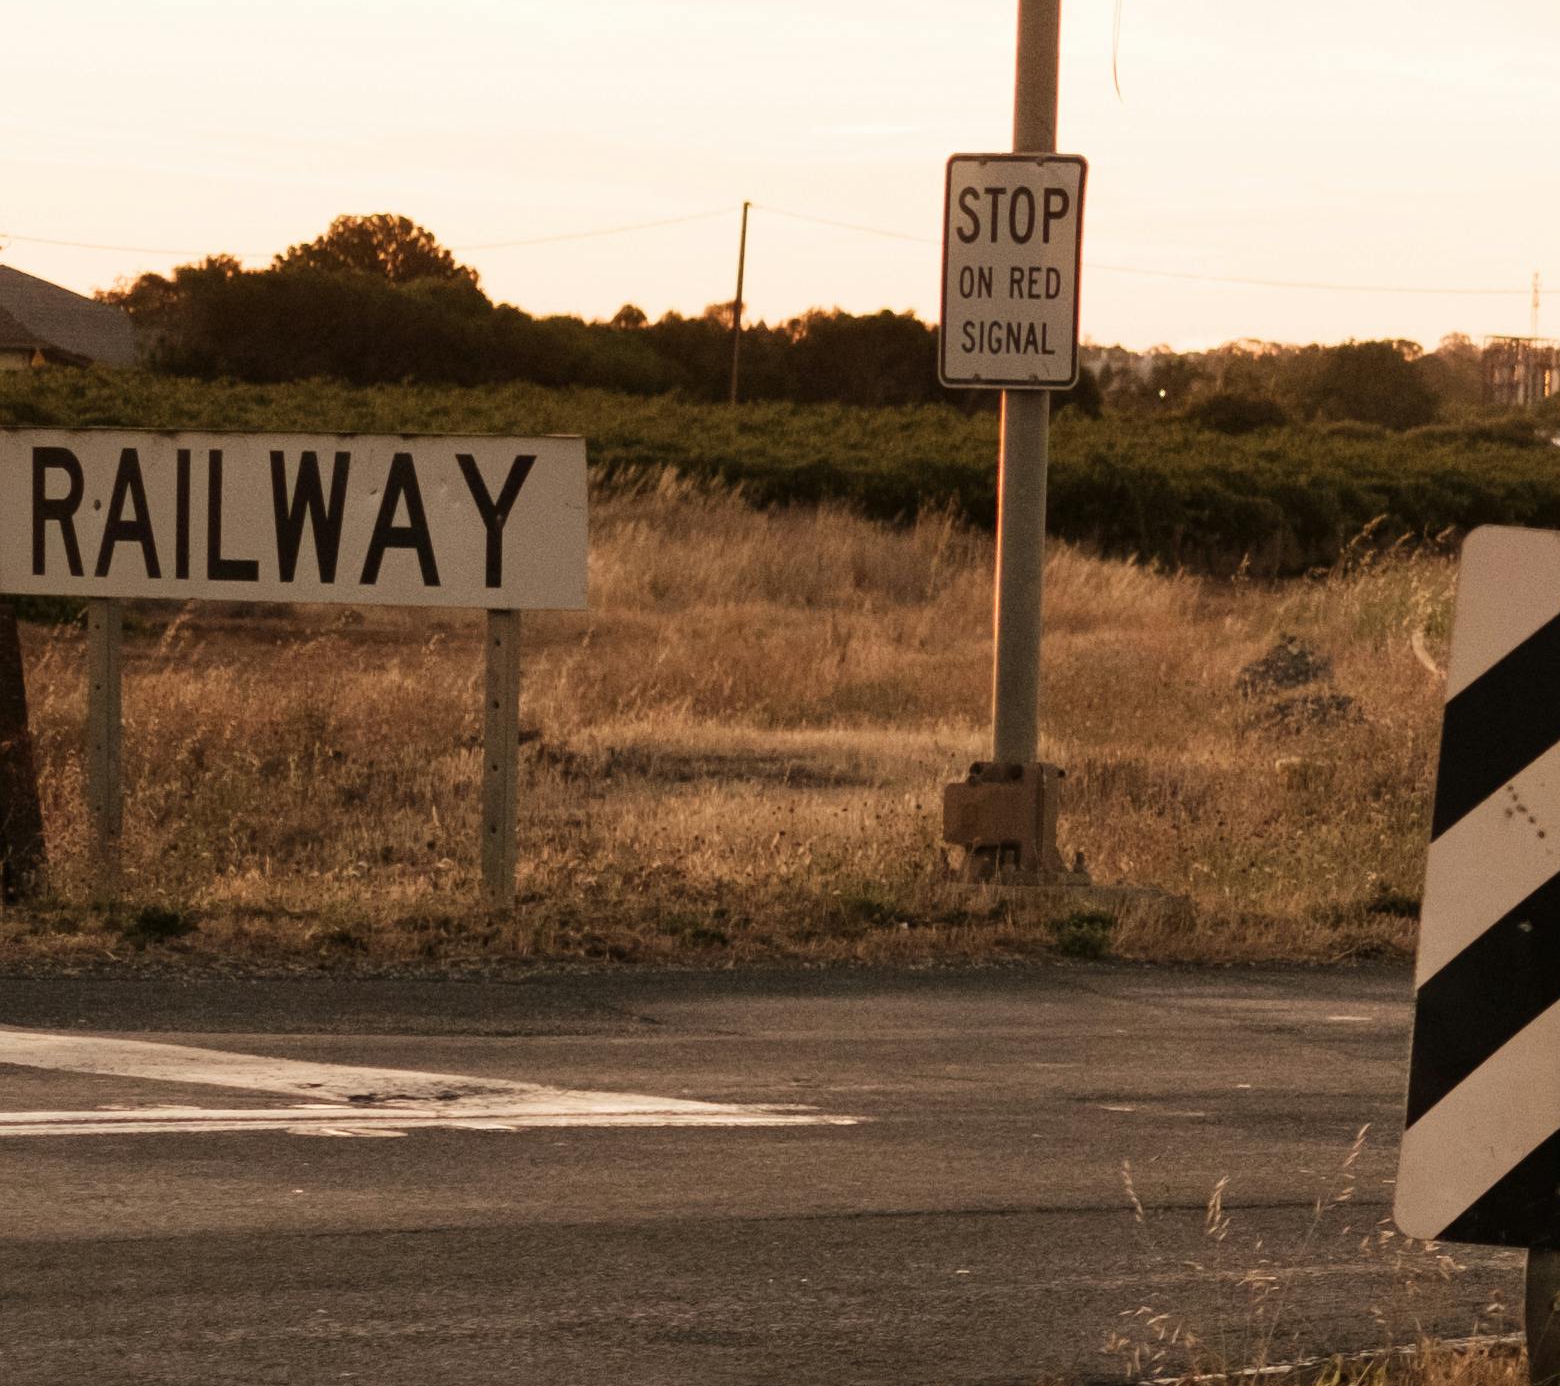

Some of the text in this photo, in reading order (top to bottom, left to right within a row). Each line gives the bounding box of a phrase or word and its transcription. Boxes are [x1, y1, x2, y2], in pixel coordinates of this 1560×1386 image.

[956, 186, 1070, 244] STOP
[959, 266, 1061, 299] ON RED
[961, 321, 1056, 354] SIGNAL
[31, 446, 537, 589] RAILWAY
